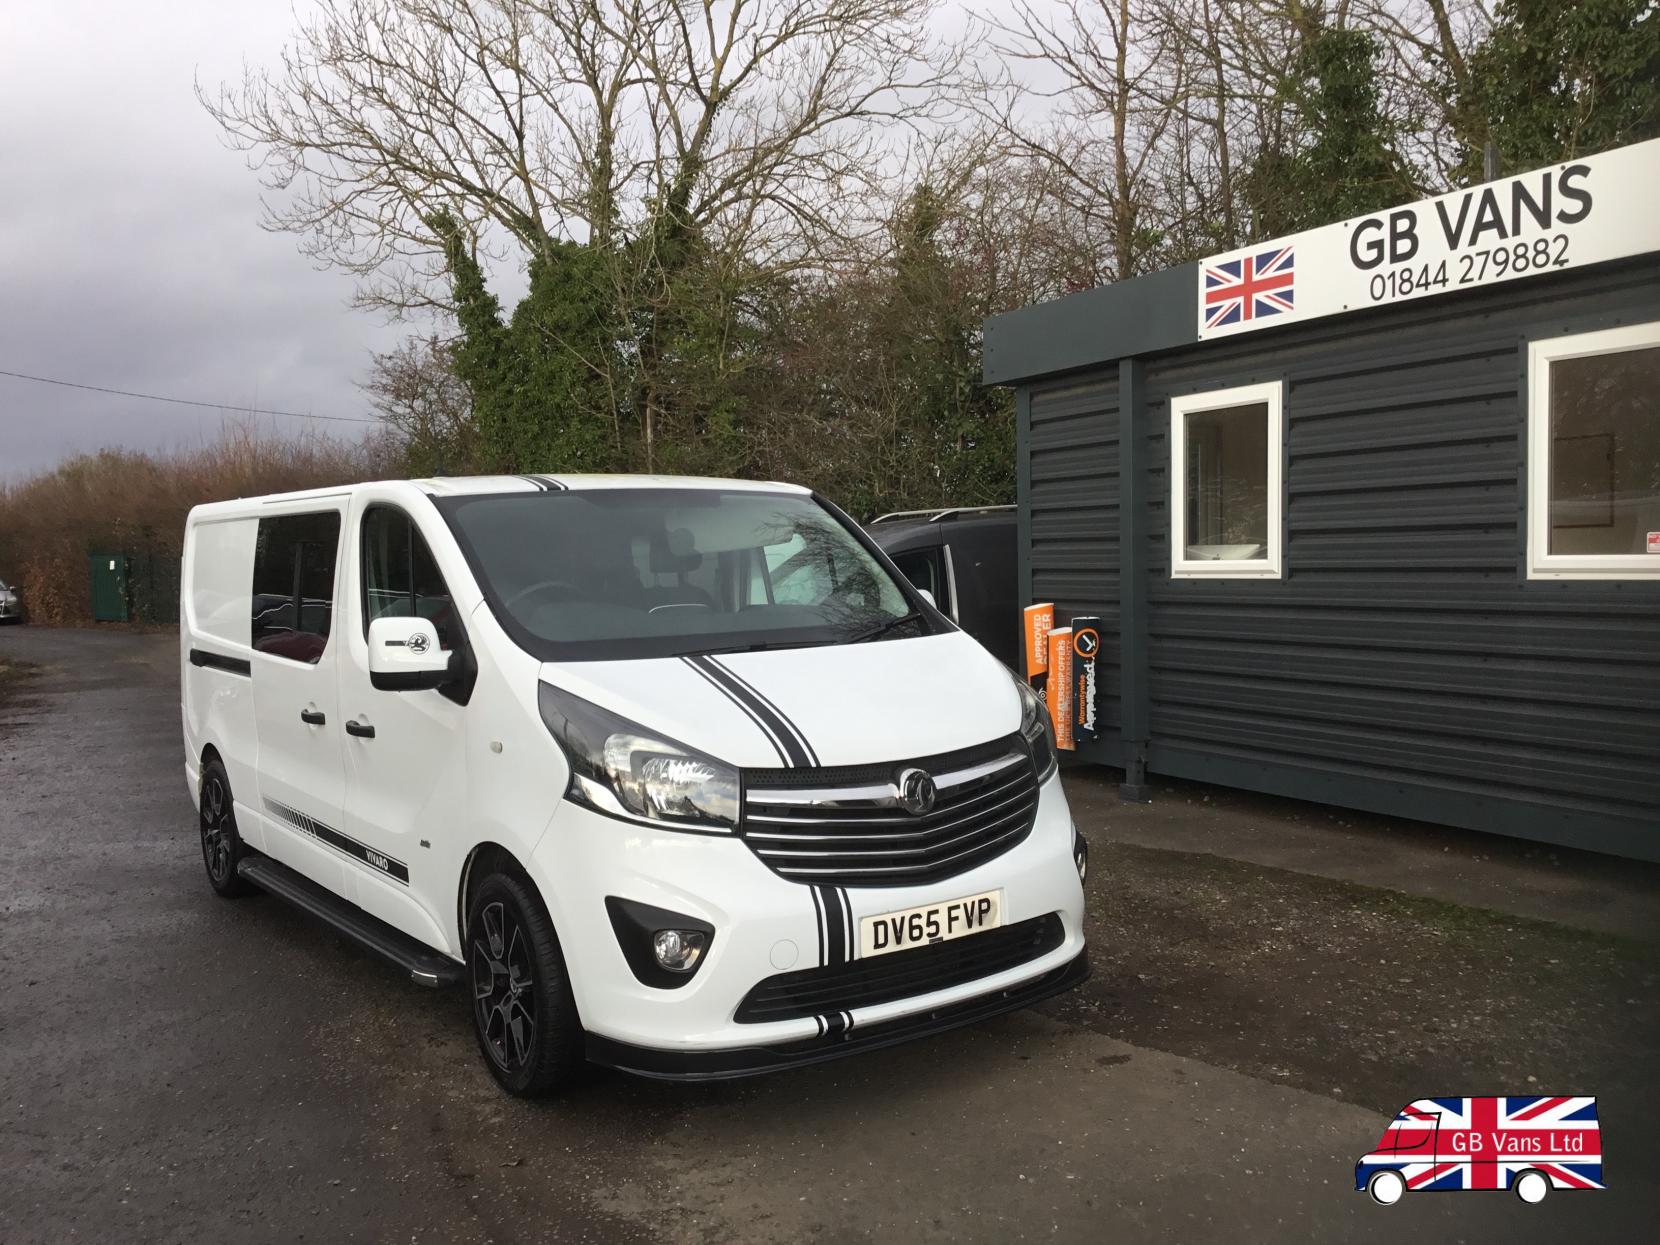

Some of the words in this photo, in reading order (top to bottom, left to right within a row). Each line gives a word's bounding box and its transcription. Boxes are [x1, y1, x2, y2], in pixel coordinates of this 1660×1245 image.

[1350, 209, 1419, 270] GB
[1435, 164, 1593, 252] VANS
[1370, 260, 1449, 301] 01844
[1458, 233, 1570, 285] 279882
[1034, 614, 1043, 665] APPROVED
[1078, 674, 1086, 725] Warrantywise
[1057, 723, 1065, 742] THIS
[365, 849, 389, 871] VIVARO
[872, 909, 940, 950] DV65
[947, 897, 991, 934] FVP
